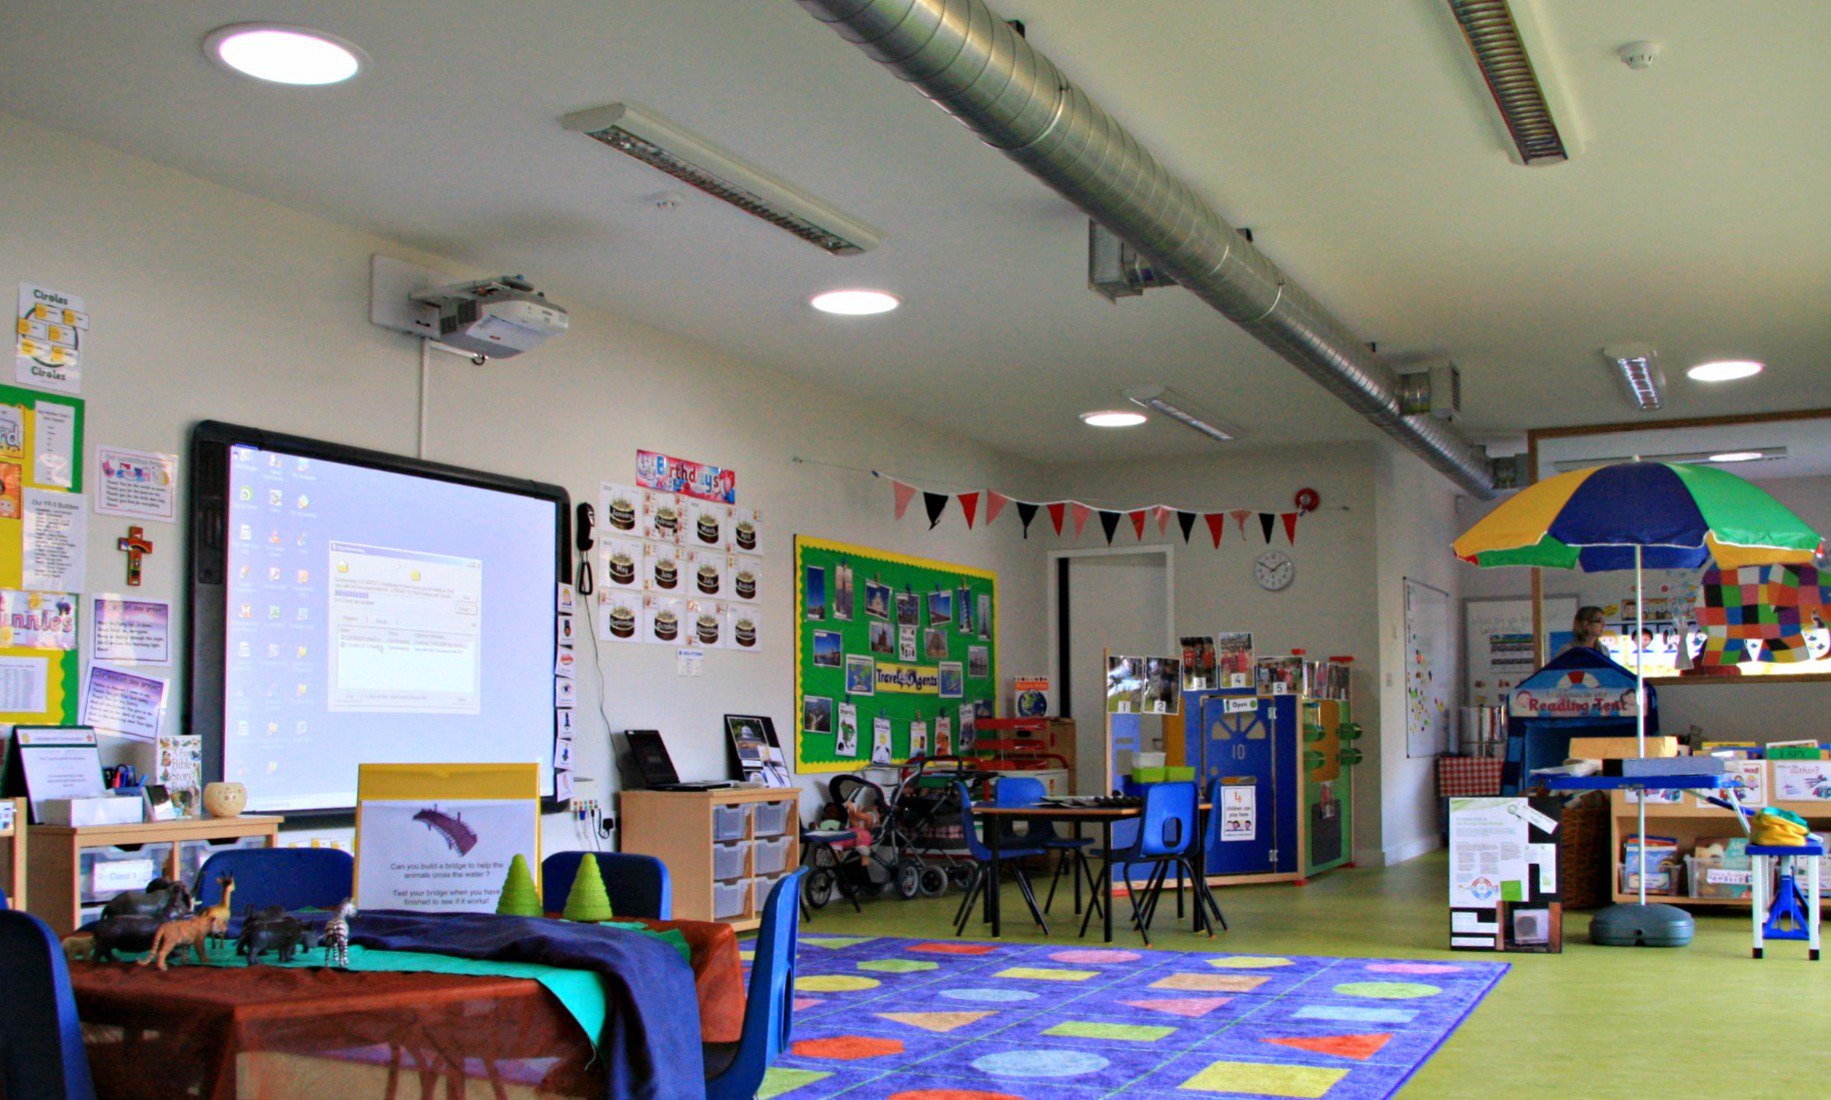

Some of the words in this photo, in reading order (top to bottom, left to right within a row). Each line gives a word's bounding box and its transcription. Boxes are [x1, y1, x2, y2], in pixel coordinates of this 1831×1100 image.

[656, 455, 719, 494] Brthdays
[1157, 703, 1164, 711] 2
[1232, 701, 1248, 709] Open
[1528, 697, 1590, 716] Reading
[1593, 697, 1627, 711] Tent
[1232, 744, 1245, 760] 10
[1789, 766, 1819, 775] author?
[406, 864, 419, 872] you
[445, 863, 466, 871] bridge
[476, 862, 491, 870] help
[393, 889, 408, 897] Test
[409, 890, 424, 898] your
[426, 889, 447, 898] bridge
